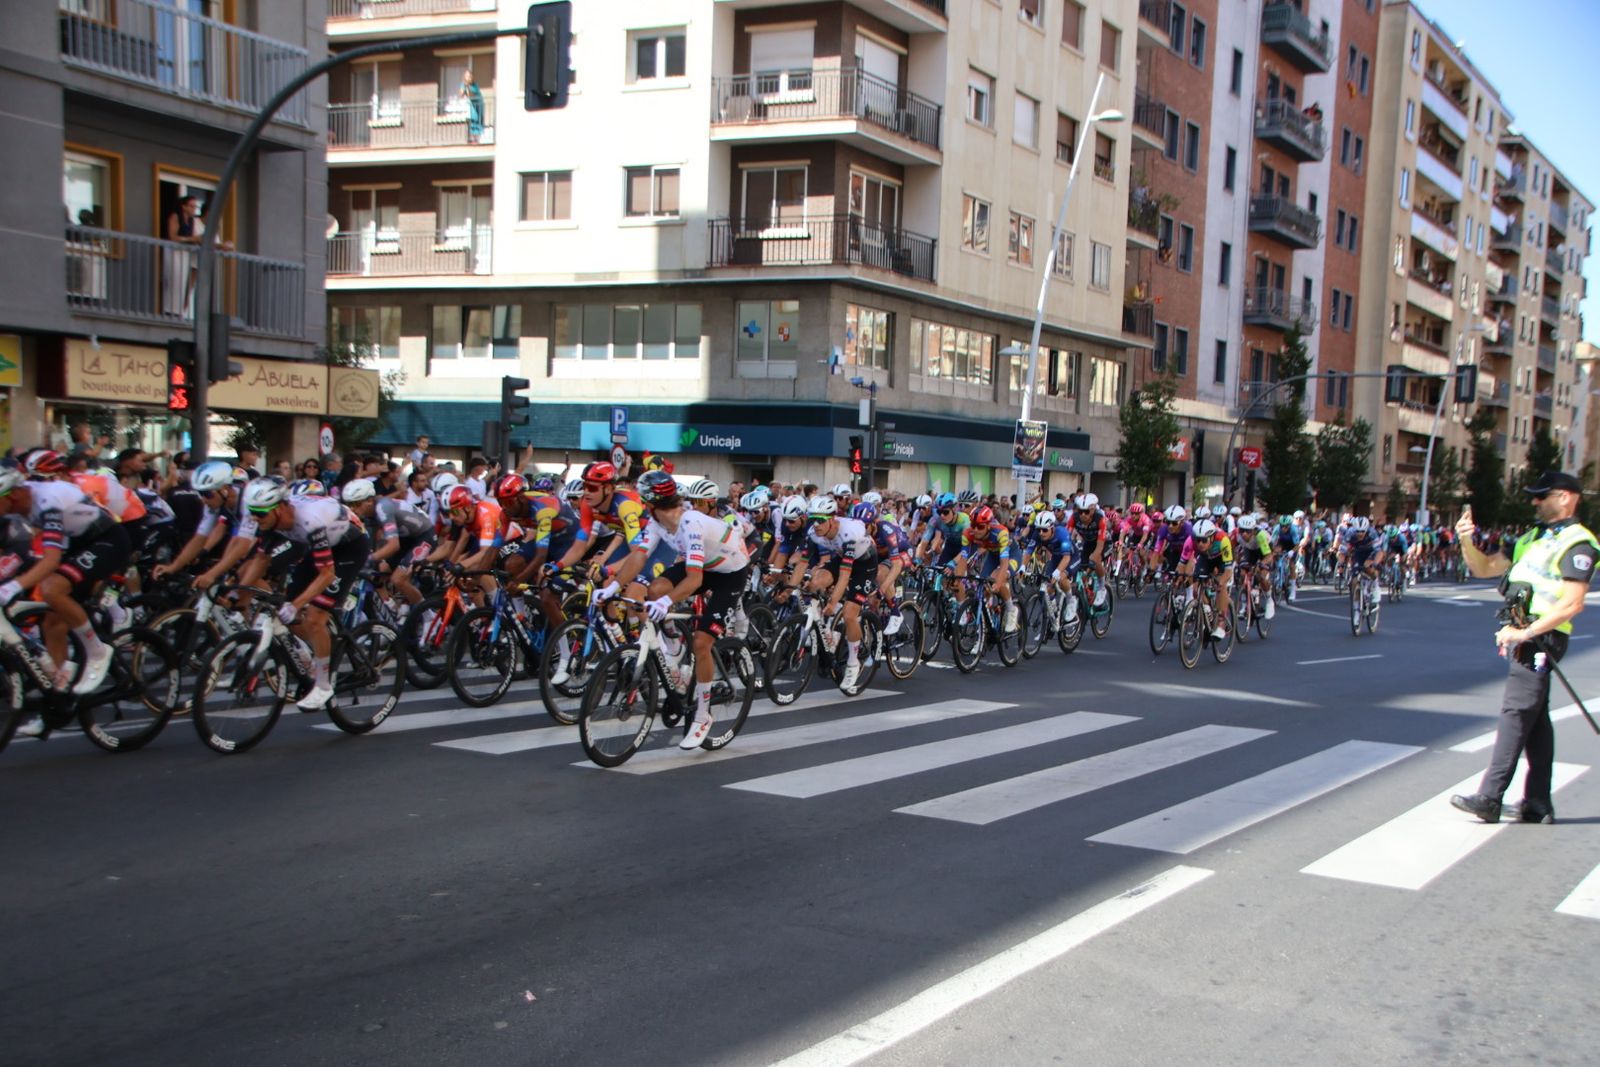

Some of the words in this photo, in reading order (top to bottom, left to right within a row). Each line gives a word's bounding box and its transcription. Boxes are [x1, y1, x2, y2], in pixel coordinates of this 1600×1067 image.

[81, 349, 106, 375] LA
[111, 353, 166, 378] TAHO
[81, 379, 131, 394] boutique
[135, 385, 152, 394] del
[153, 388, 166, 398] pa
[614, 409, 625, 431] P
[700, 434, 741, 450] Unicaja
[655, 650, 677, 691] COLNAGO
